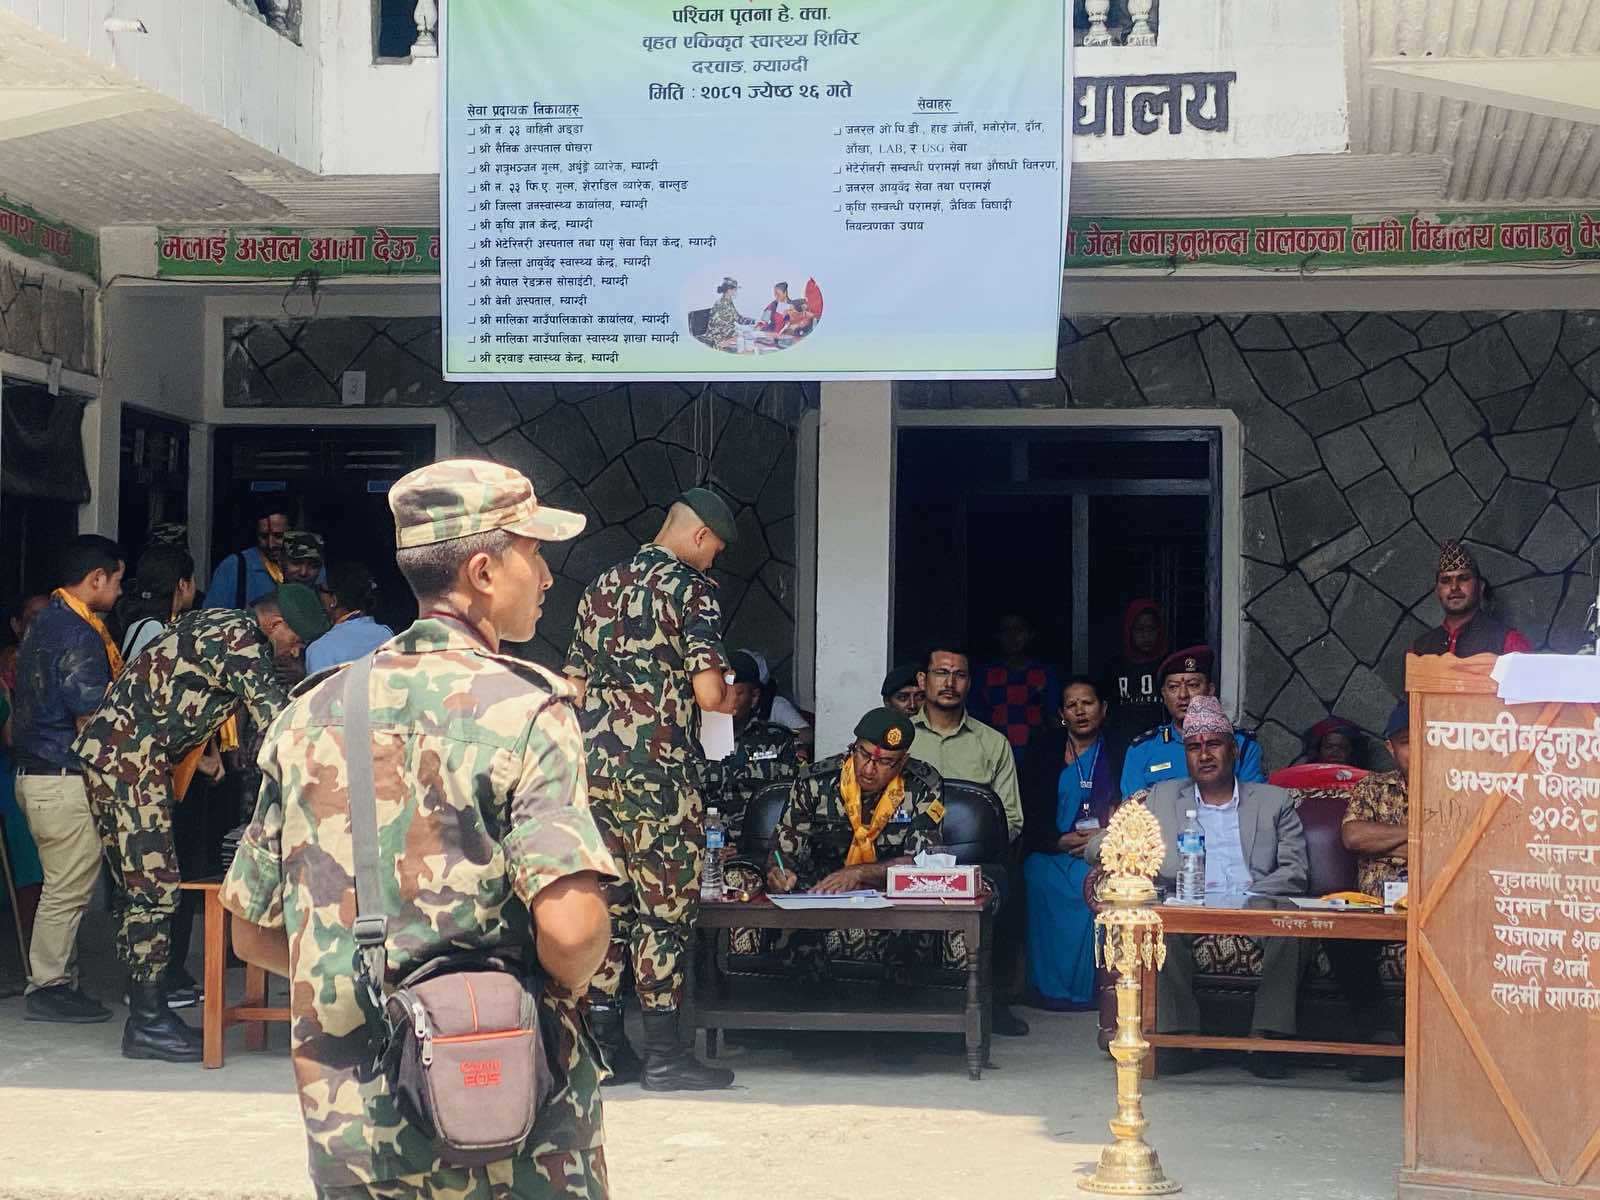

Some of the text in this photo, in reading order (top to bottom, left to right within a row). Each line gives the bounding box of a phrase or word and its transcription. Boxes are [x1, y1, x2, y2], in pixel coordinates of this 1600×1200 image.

[672, 5, 724, 24] पश्चिम
[730, 7, 772, 26] पृतना
[777, 4, 794, 24] हे.
[642, 29, 861, 52] वृहत एकिकृत स्वास्थ्य शिविर
[753, 55, 809, 73] म्याग्दी
[649, 82, 685, 100] मिति
[701, 84, 741, 100] २०८१
[748, 81, 794, 99] ज्येष्ठ
[799, 84, 820, 100] २६
[826, 80, 853, 98] गते
[467, 103, 488, 116] सेवा
[493, 105, 528, 117] प्रदायक
[480, 124, 491, 135] श्री
[509, 126, 520, 136] २३
[526, 123, 553, 135] वाहिनी
[845, 126, 875, 136] जनरल
[931, 125, 948, 136] हाड
[480, 141, 592, 154] श्री सैनिक अस्पताल पोखरा
[909, 144, 918, 155] र
[949, 140, 968, 152] सेवा
[480, 161, 491, 172] श्री
[631, 159, 659, 171] म्याग्दी
[964, 161, 983, 172] तथा
[480, 181, 491, 192] श्री
[509, 182, 521, 193] २३
[845, 183, 875, 194] जनरल
[915, 180, 933, 192] सेवा
[937, 182, 956, 192] तथा
[480, 200, 491, 211] श्री
[495, 199, 521, 211] जिल्ला
[620, 197, 648, 210] म्याग्दी
[845, 200, 867, 215] कृषि
[480, 218, 492, 230] श्री
[495, 218, 515, 233] कृषि
[518, 219, 536, 230] ज्ञान
[566, 217, 593, 230] म्याग्दी
[899, 221, 925, 231] उपाय
[480, 238, 492, 249] श्री
[538, 238, 574, 248] अस्पताल
[578, 239, 595, 249] तथा
[599, 239, 614, 250] पशु
[618, 236, 636, 249] सेवा
[688, 235, 717, 248] म्याग्दी
[1084, 222, 1123, 257] जेल
[1255, 225, 1346, 255] बालकका
[1352, 216, 1405, 253] लागि
[1500, 221, 1576, 257] बनाउनु
[235, 235, 300, 263] असल
[309, 234, 365, 262] आमा
[480, 257, 492, 268] श्री
[495, 256, 522, 268] जिल्ला
[559, 258, 593, 268] स्वास्थ्य
[623, 255, 651, 267] म्याग्दी
[480, 276, 492, 287] श्री
[495, 276, 519, 287] नेपाल
[601, 274, 629, 287] म्याग्दी
[480, 295, 492, 306] श्री
[560, 294, 588, 306] म्याग्दी
[480, 313, 492, 325] श्री
[495, 313, 529, 326] मालिका
[642, 312, 671, 325] म्याग्दी
[480, 332, 492, 343] श्री
[495, 332, 528, 344] मालिका
[586, 334, 619, 344] स्वास्थ्य
[623, 334, 647, 344] शाखा
[651, 331, 679, 344] म्याग्दी
[480, 352, 492, 363] श्री
[529, 353, 561, 363] स्वास्थ्य
[592, 351, 619, 364] म्याग्दी
